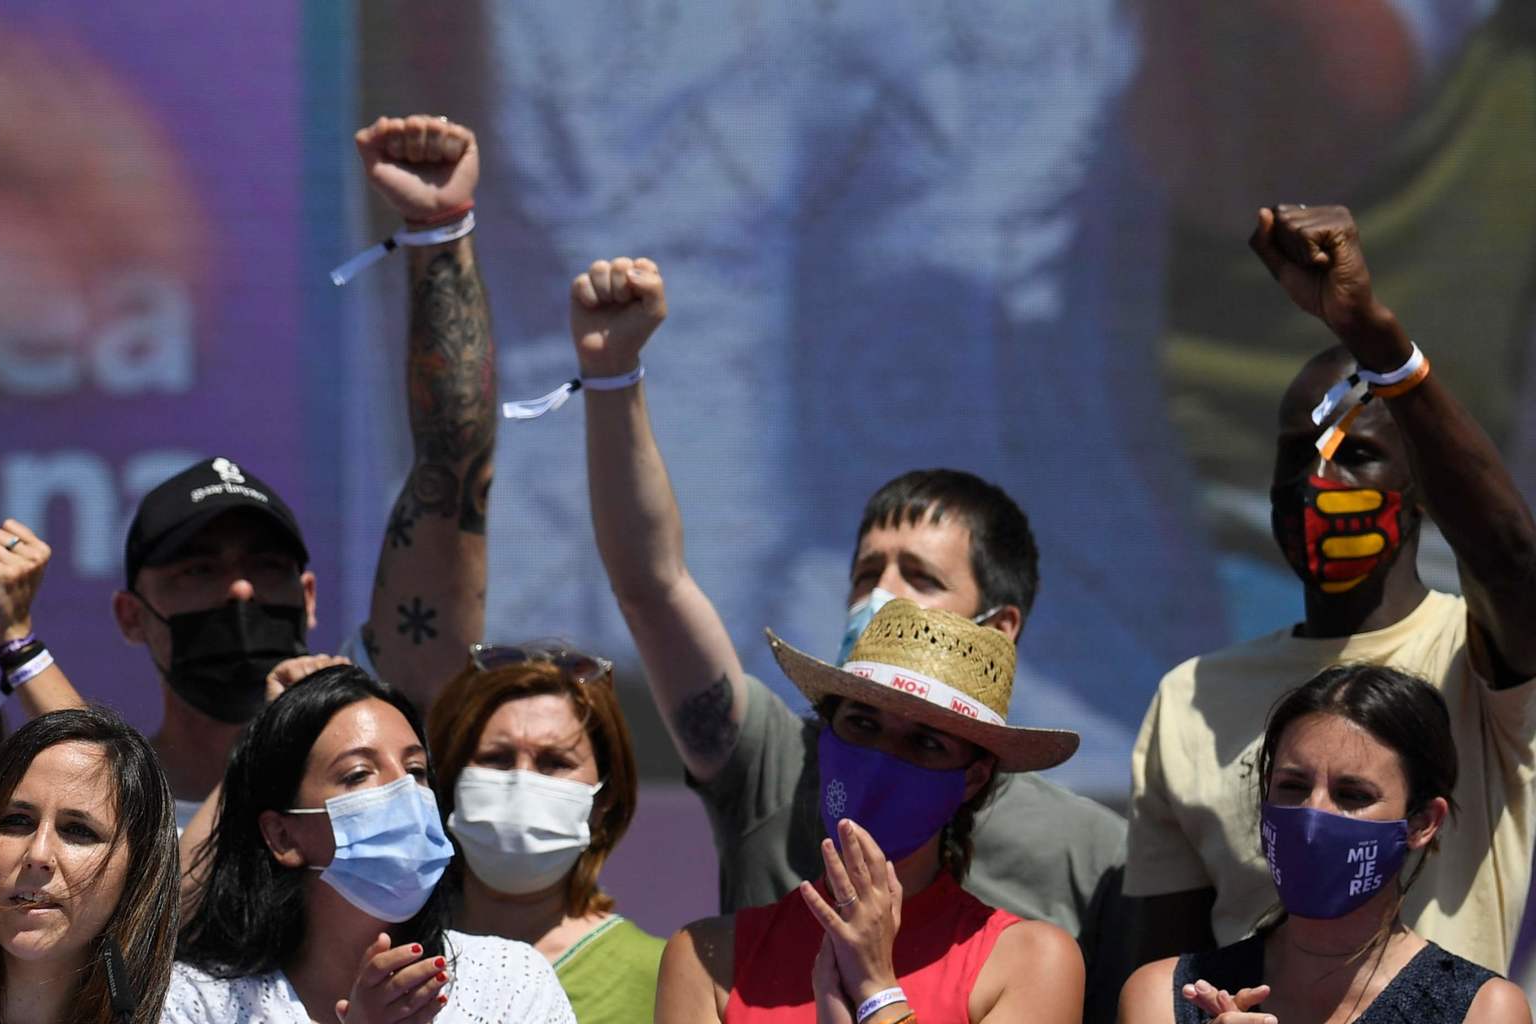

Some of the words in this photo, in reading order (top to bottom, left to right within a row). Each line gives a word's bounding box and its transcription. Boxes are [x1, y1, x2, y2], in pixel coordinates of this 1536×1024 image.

[1347, 844, 1378, 864] MU
[1354, 860, 1376, 879] JE
[1349, 873, 1383, 897] RES
